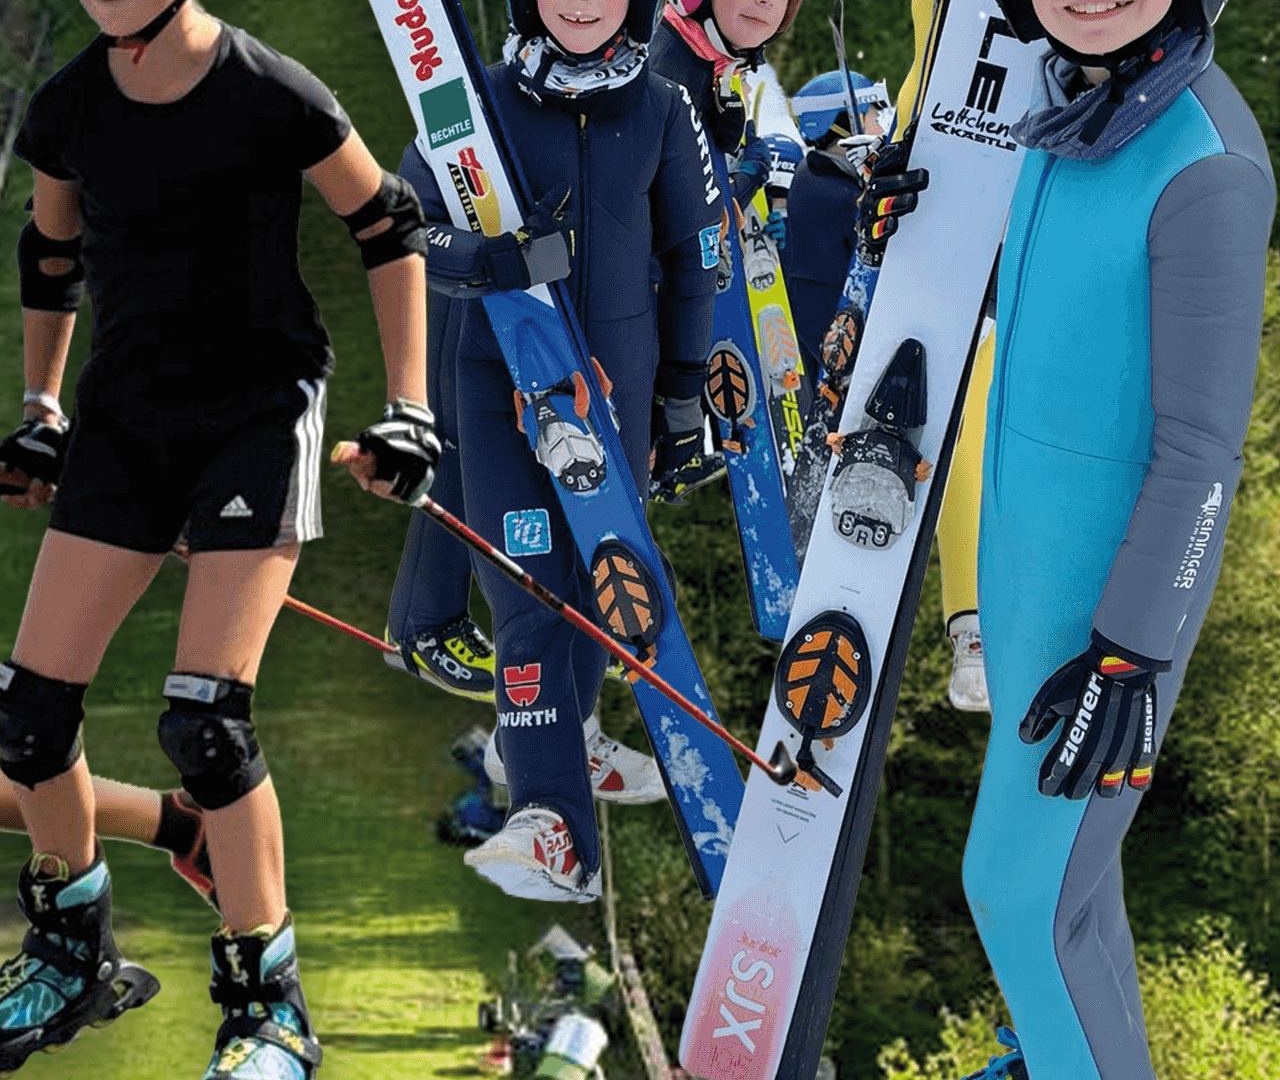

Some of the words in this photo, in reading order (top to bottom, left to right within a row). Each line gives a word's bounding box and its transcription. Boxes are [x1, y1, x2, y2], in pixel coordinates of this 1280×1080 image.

[431, 118, 472, 144] BECHTLE
[1060, 671, 1104, 766] ziener
[1143, 693, 1153, 753] ziener
[713, 949, 776, 1054] SJX
